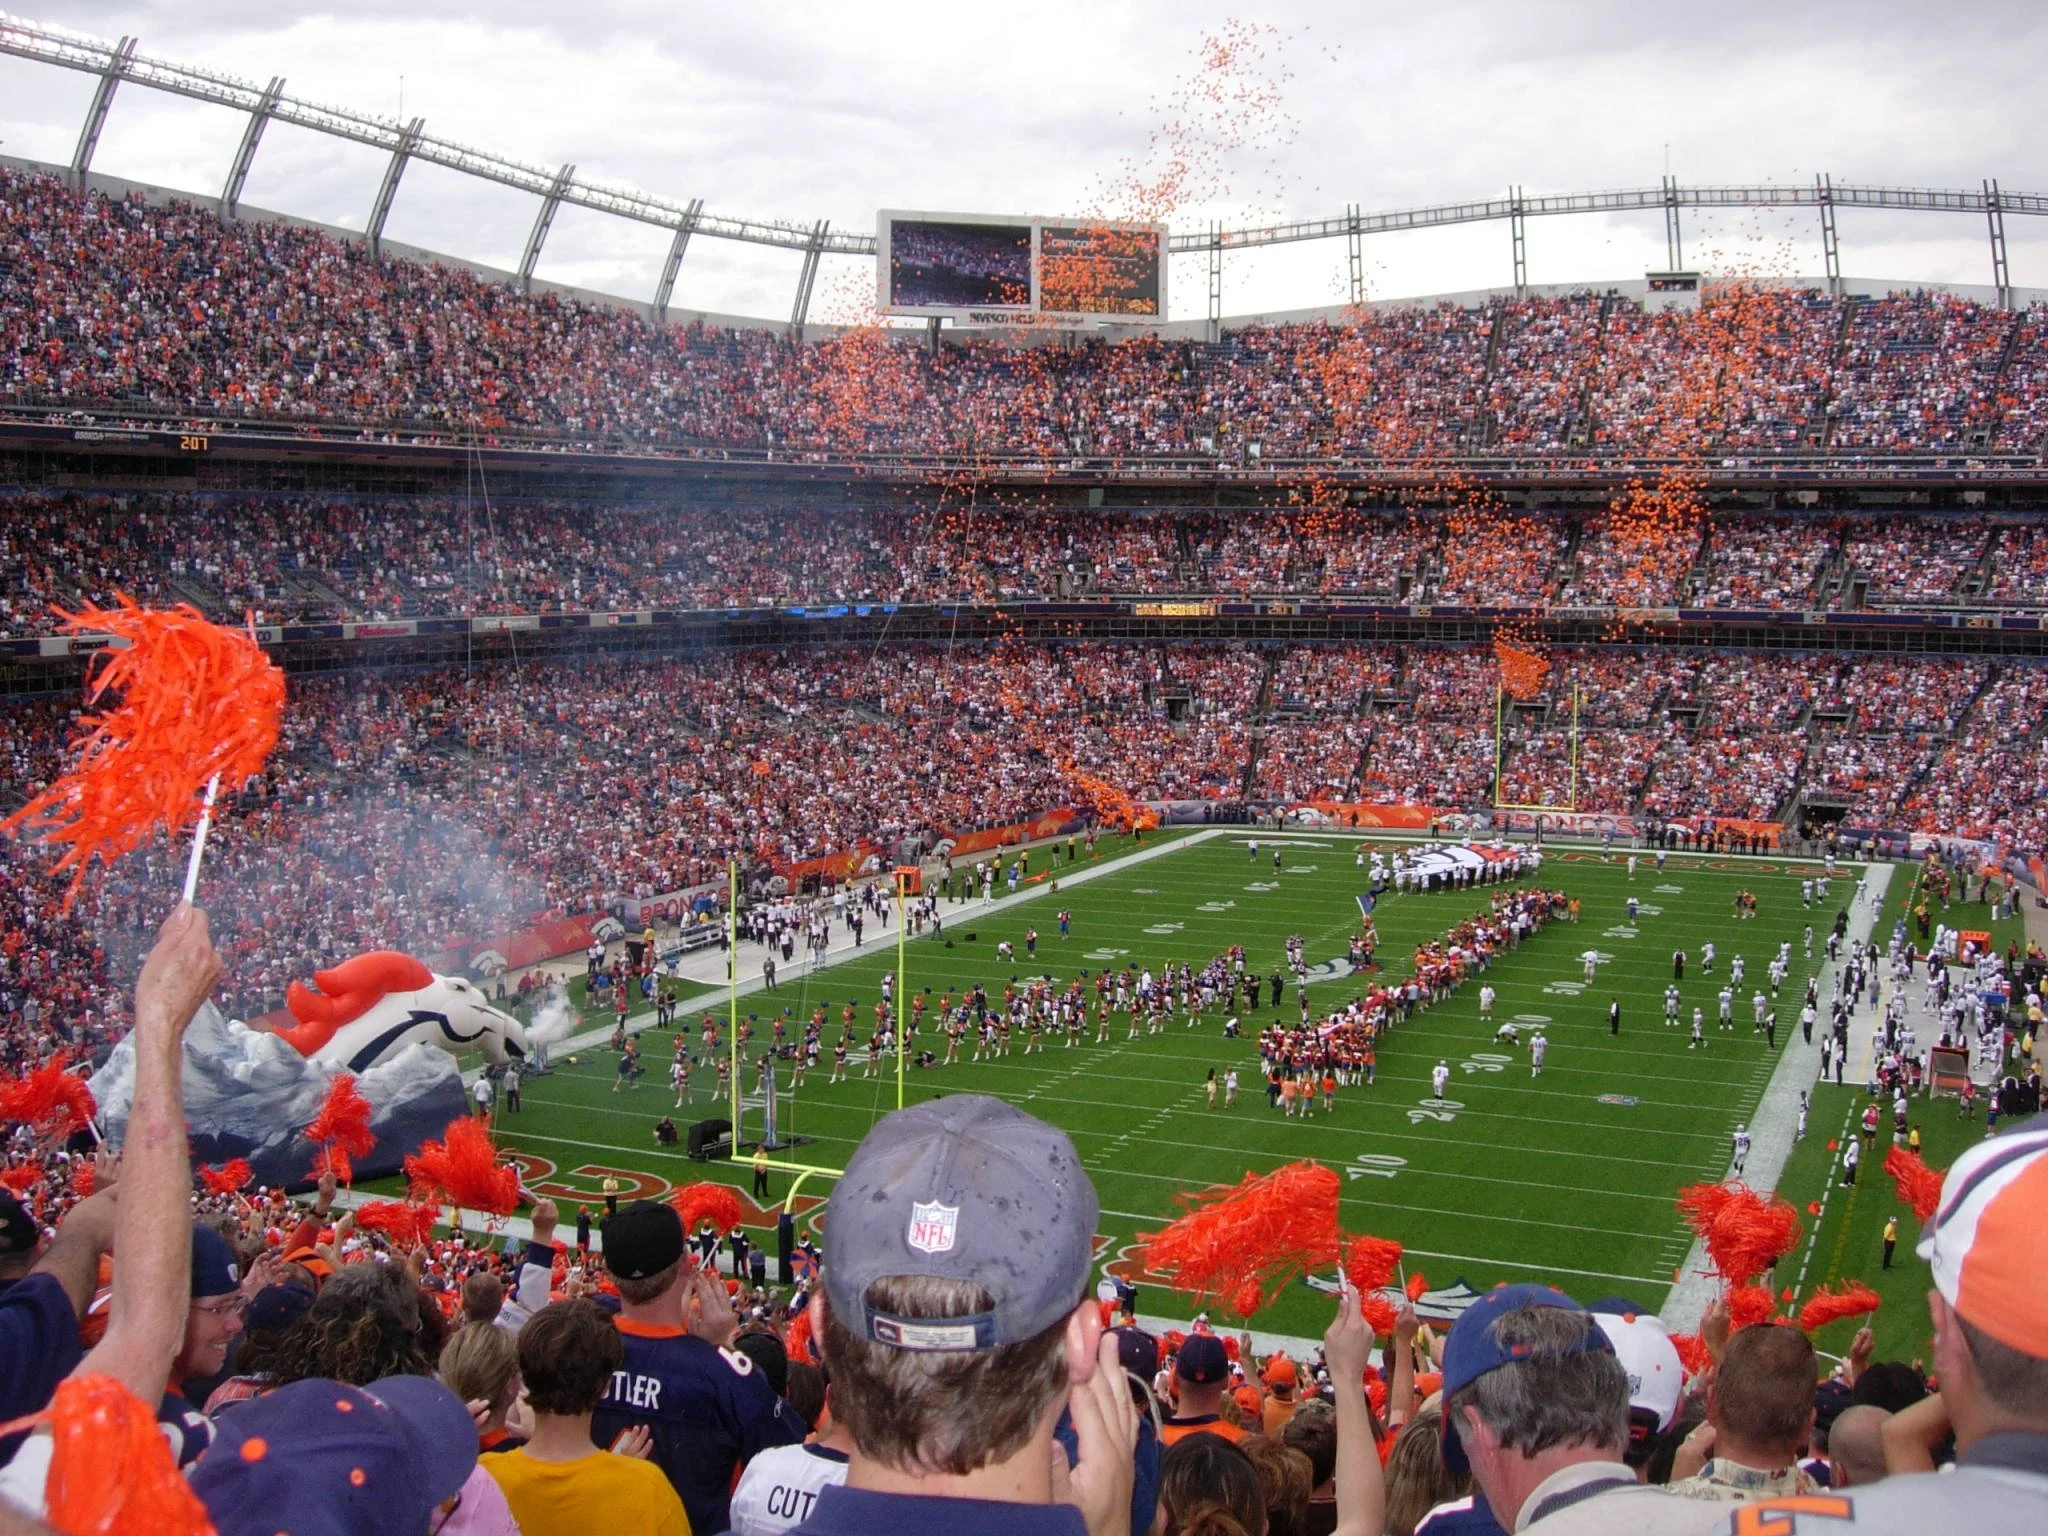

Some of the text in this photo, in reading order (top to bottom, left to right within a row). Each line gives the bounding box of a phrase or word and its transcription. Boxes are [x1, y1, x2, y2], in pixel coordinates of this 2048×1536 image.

[2000, 471, 2035, 479] JACKSON
[1345, 1154, 1408, 1181] 10
[914, 1221, 948, 1247] NFL
[604, 1371, 660, 1410] TLER
[767, 1485, 817, 1522] CUT
